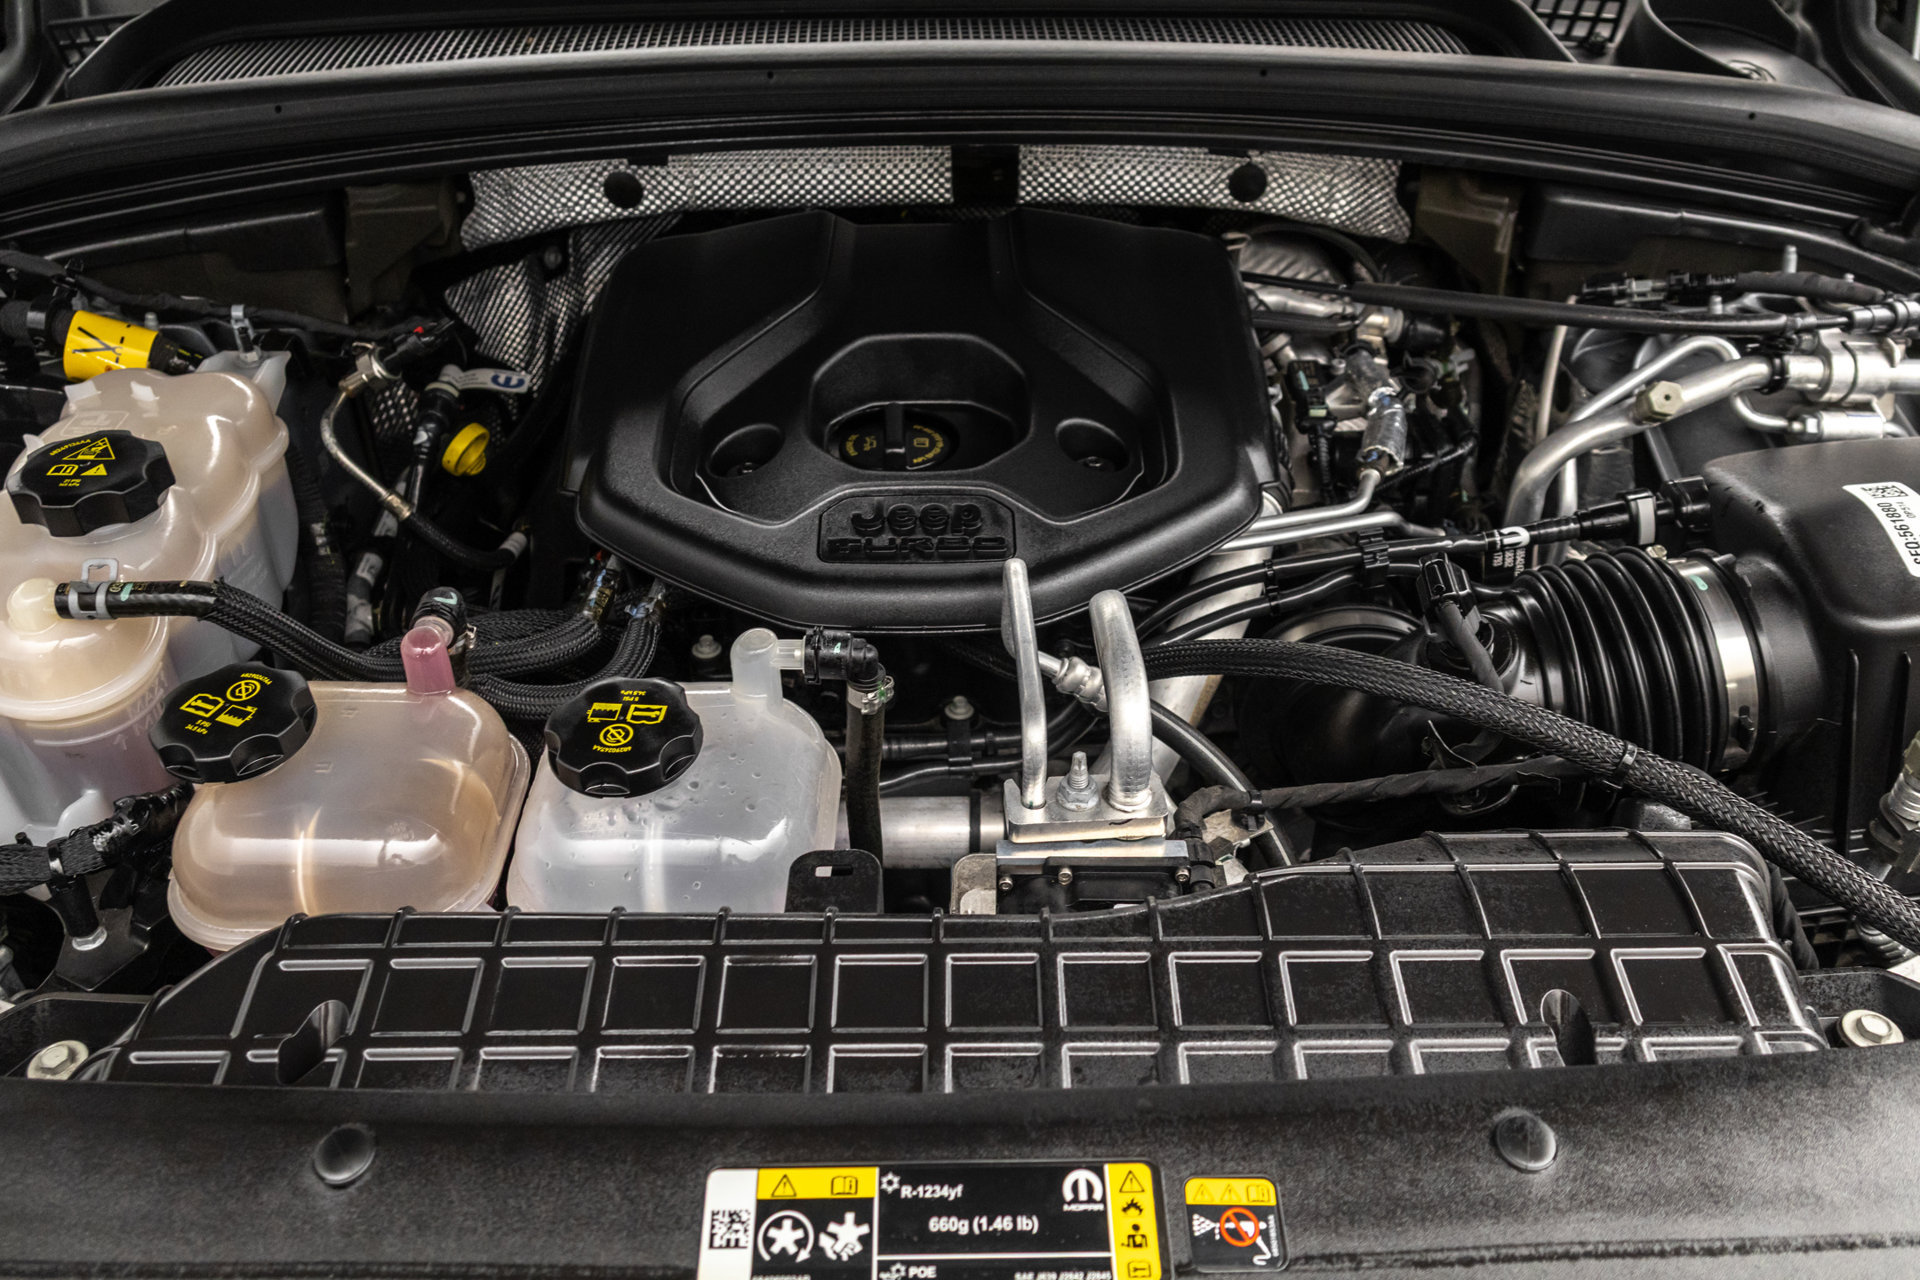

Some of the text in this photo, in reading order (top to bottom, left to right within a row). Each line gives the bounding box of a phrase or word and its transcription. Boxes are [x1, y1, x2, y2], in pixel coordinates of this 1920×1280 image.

[851, 500, 982, 536] Jeep
[900, 1183, 964, 1201] R-1234yf
[929, 1214, 1039, 1235] 660g (1.46 lb)
[908, 1265, 937, 1278] POE
